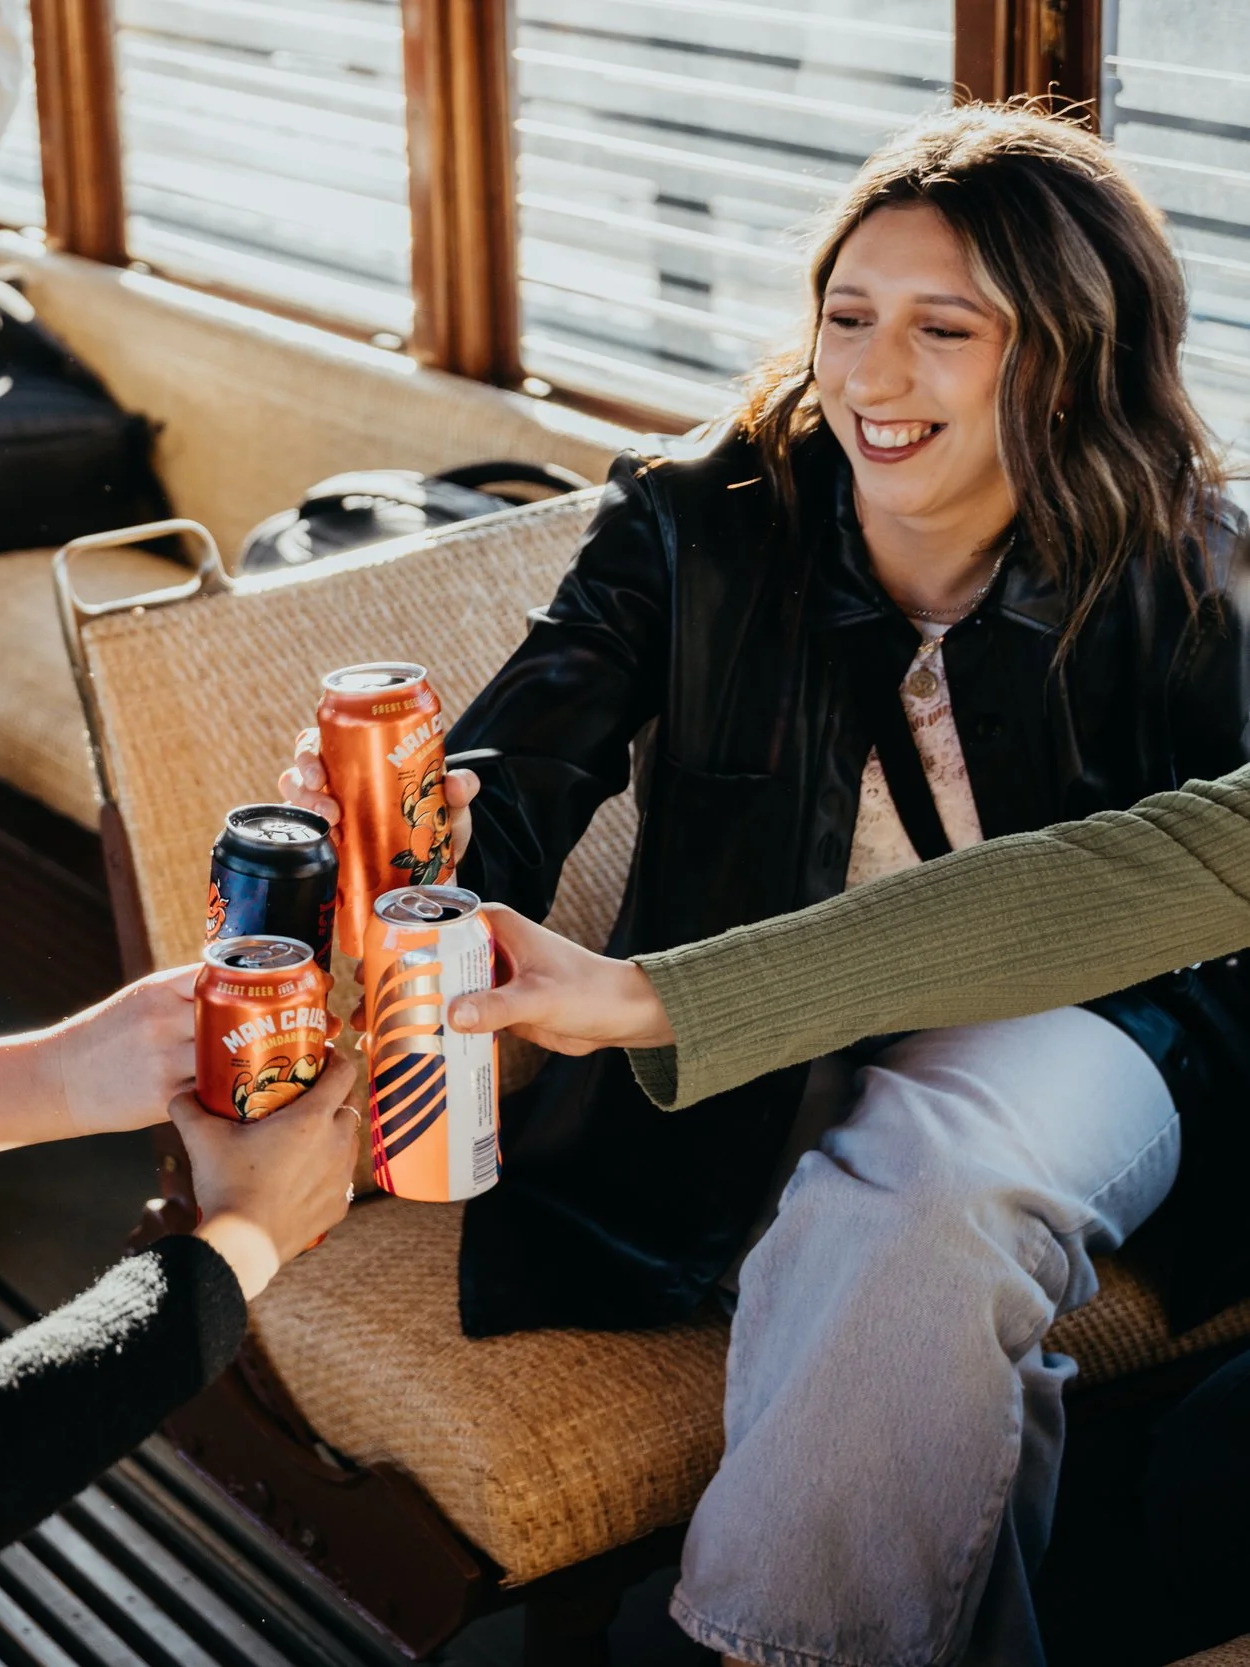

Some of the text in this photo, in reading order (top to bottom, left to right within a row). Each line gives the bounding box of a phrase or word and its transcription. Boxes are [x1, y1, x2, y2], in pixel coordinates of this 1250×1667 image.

[387, 723, 430, 768] MAN
[216, 982, 245, 996] GREAT
[248, 986, 274, 997] BEER
[222, 1008, 326, 1054] MAN CRUS
[251, 1031, 307, 1056] ANDAR
